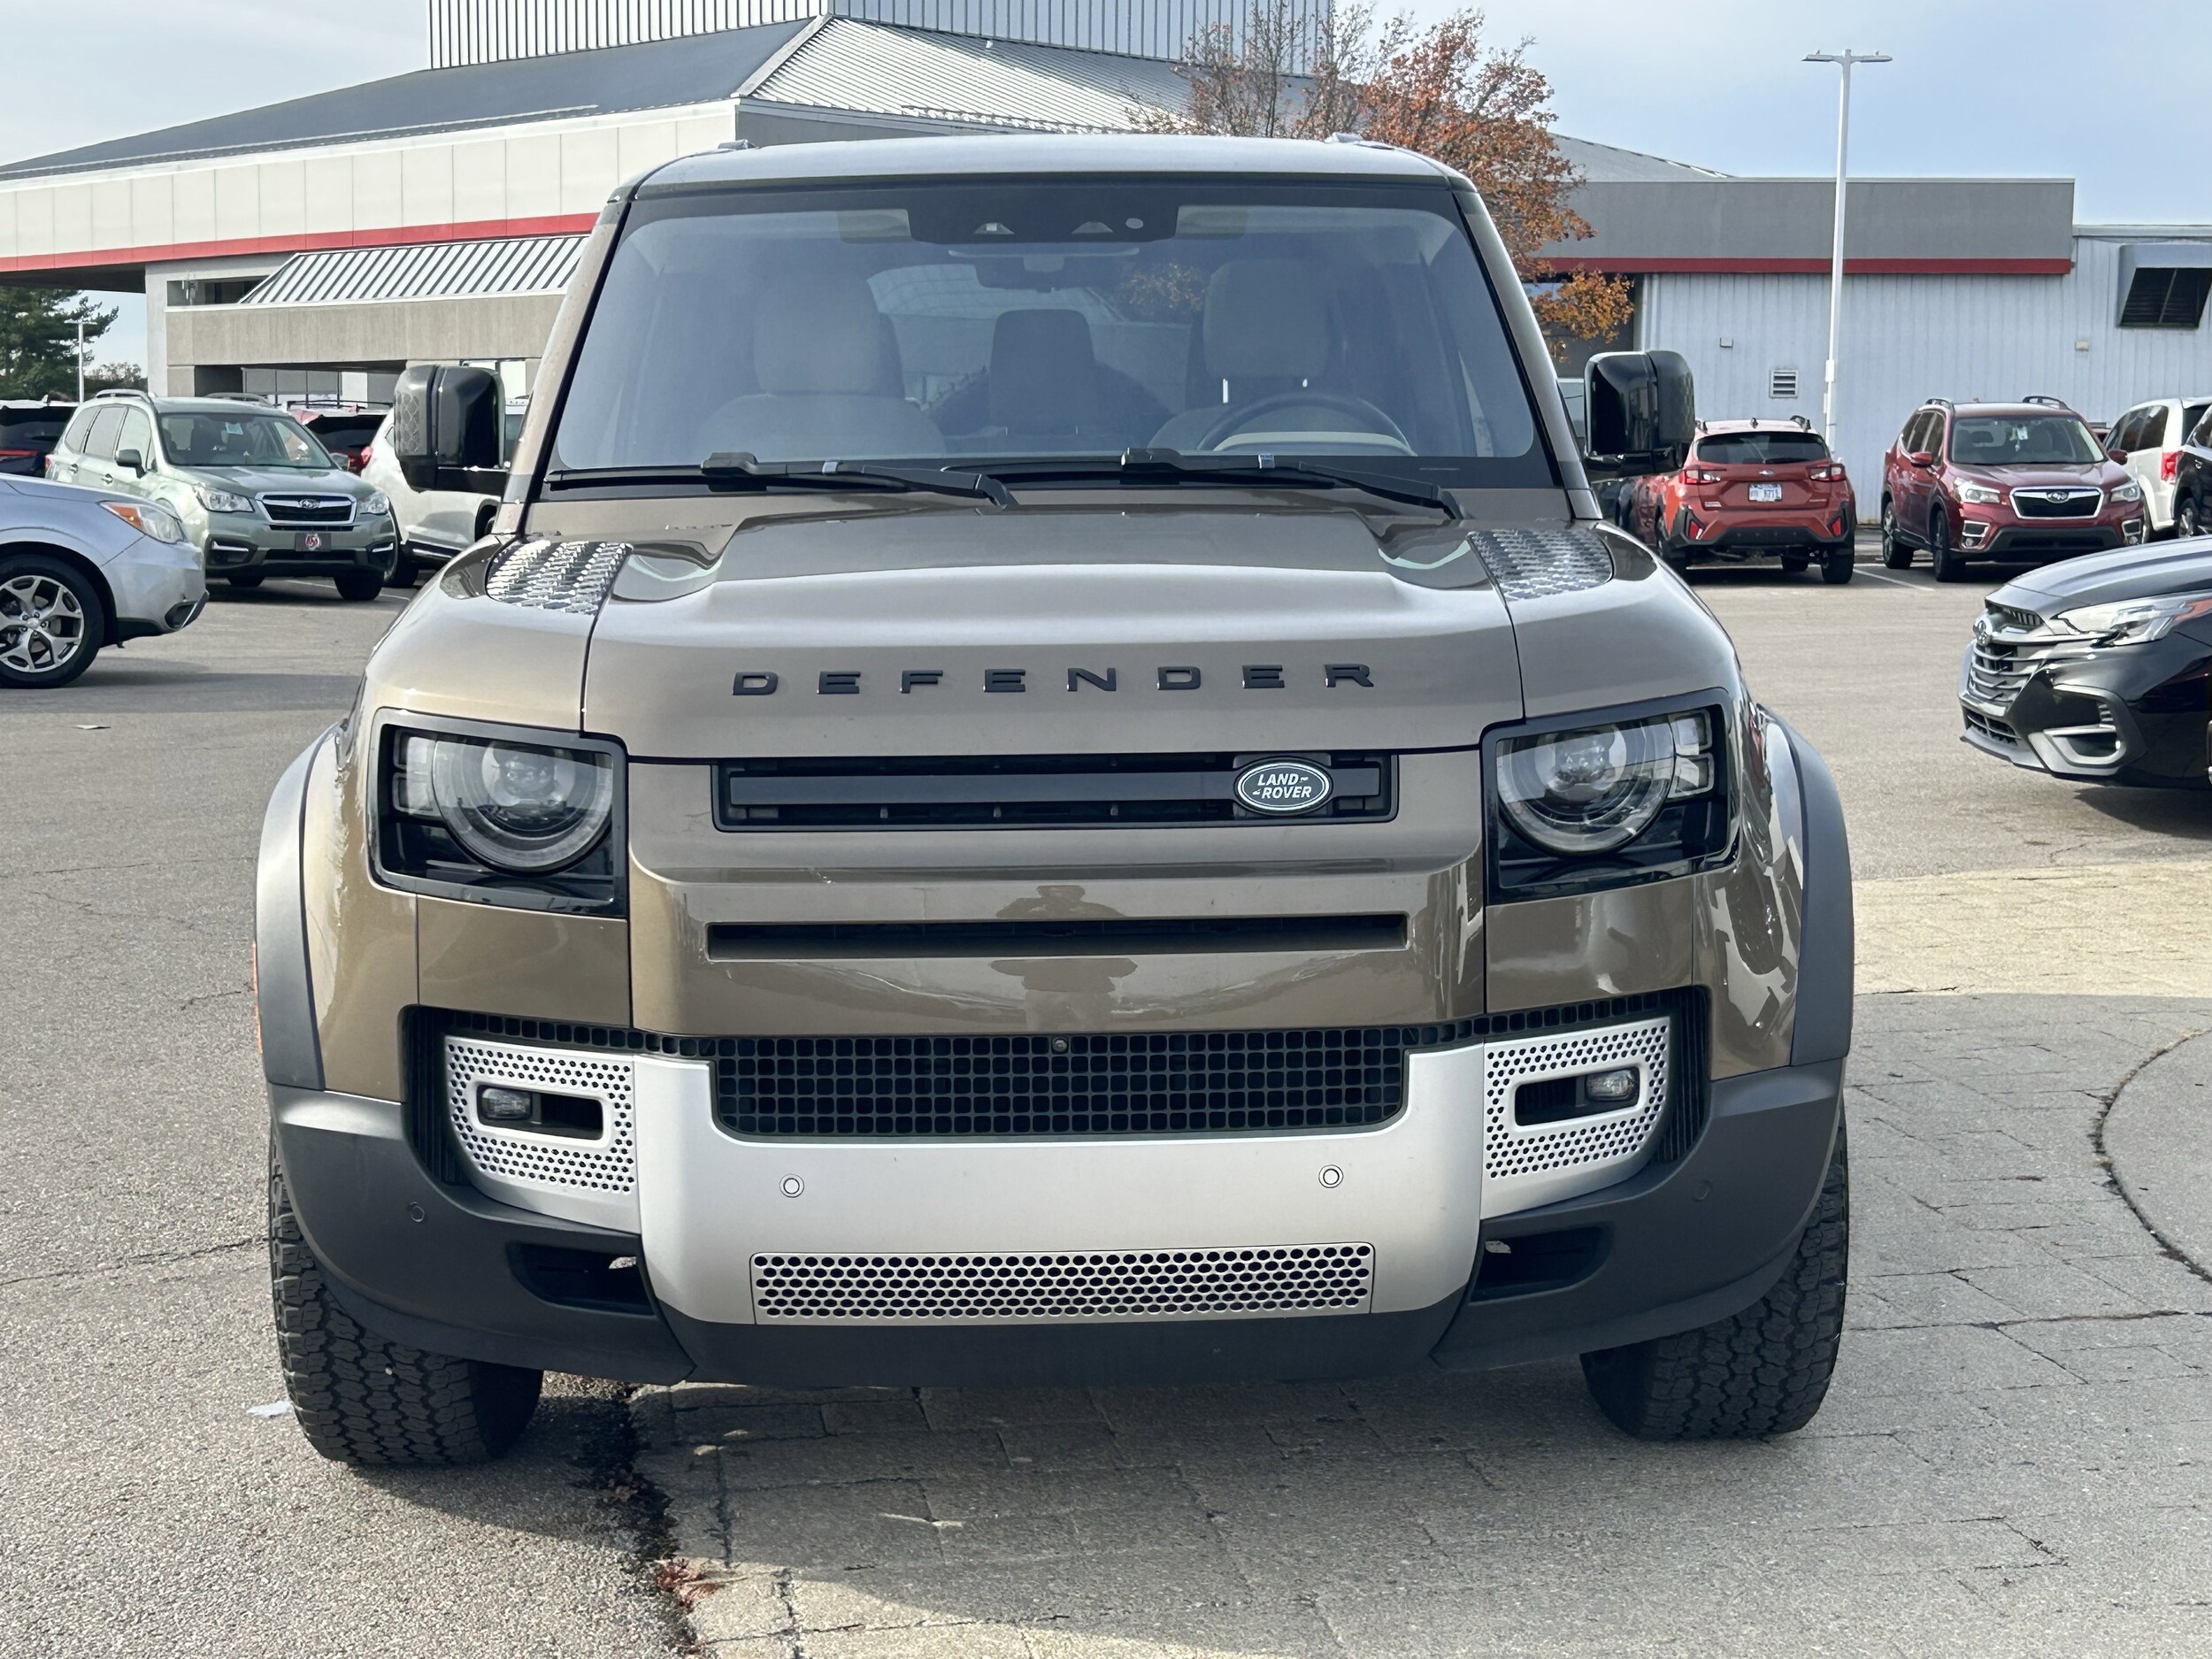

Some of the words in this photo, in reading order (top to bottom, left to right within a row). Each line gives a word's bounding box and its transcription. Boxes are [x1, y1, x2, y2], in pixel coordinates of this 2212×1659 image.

[733, 663, 1375, 696] DEFENDER
[1257, 773, 1299, 786] LAND
[1262, 786, 1312, 799] ROVER
